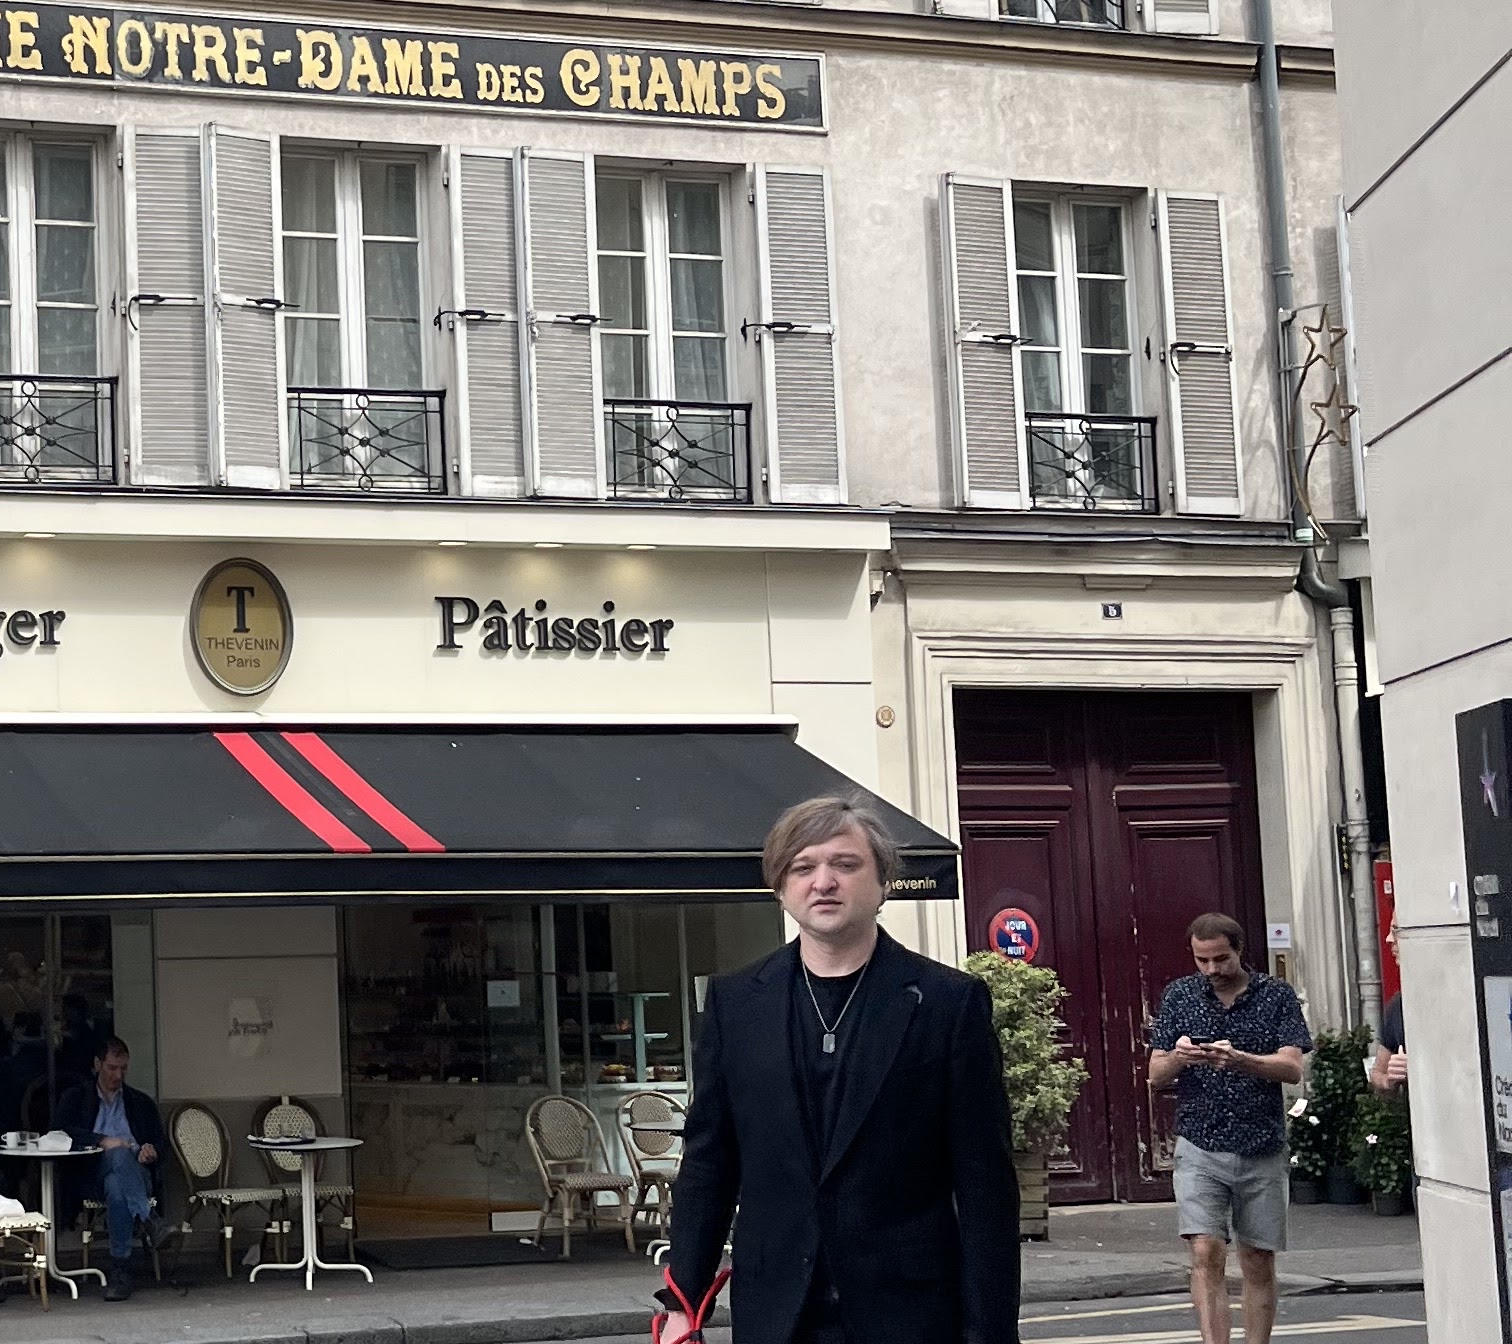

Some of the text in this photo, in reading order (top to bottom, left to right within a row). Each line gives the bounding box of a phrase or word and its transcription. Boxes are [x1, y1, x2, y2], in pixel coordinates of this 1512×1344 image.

[61, 14, 464, 99] NOTRE-DAME
[477, 62, 545, 104] DES
[560, 48, 786, 119] CHAMPS
[226, 586, 254, 633] T
[435, 596, 674, 652] Pâtissier
[206, 637, 279, 651] THEVENIN
[226, 655, 261, 668] Paris
